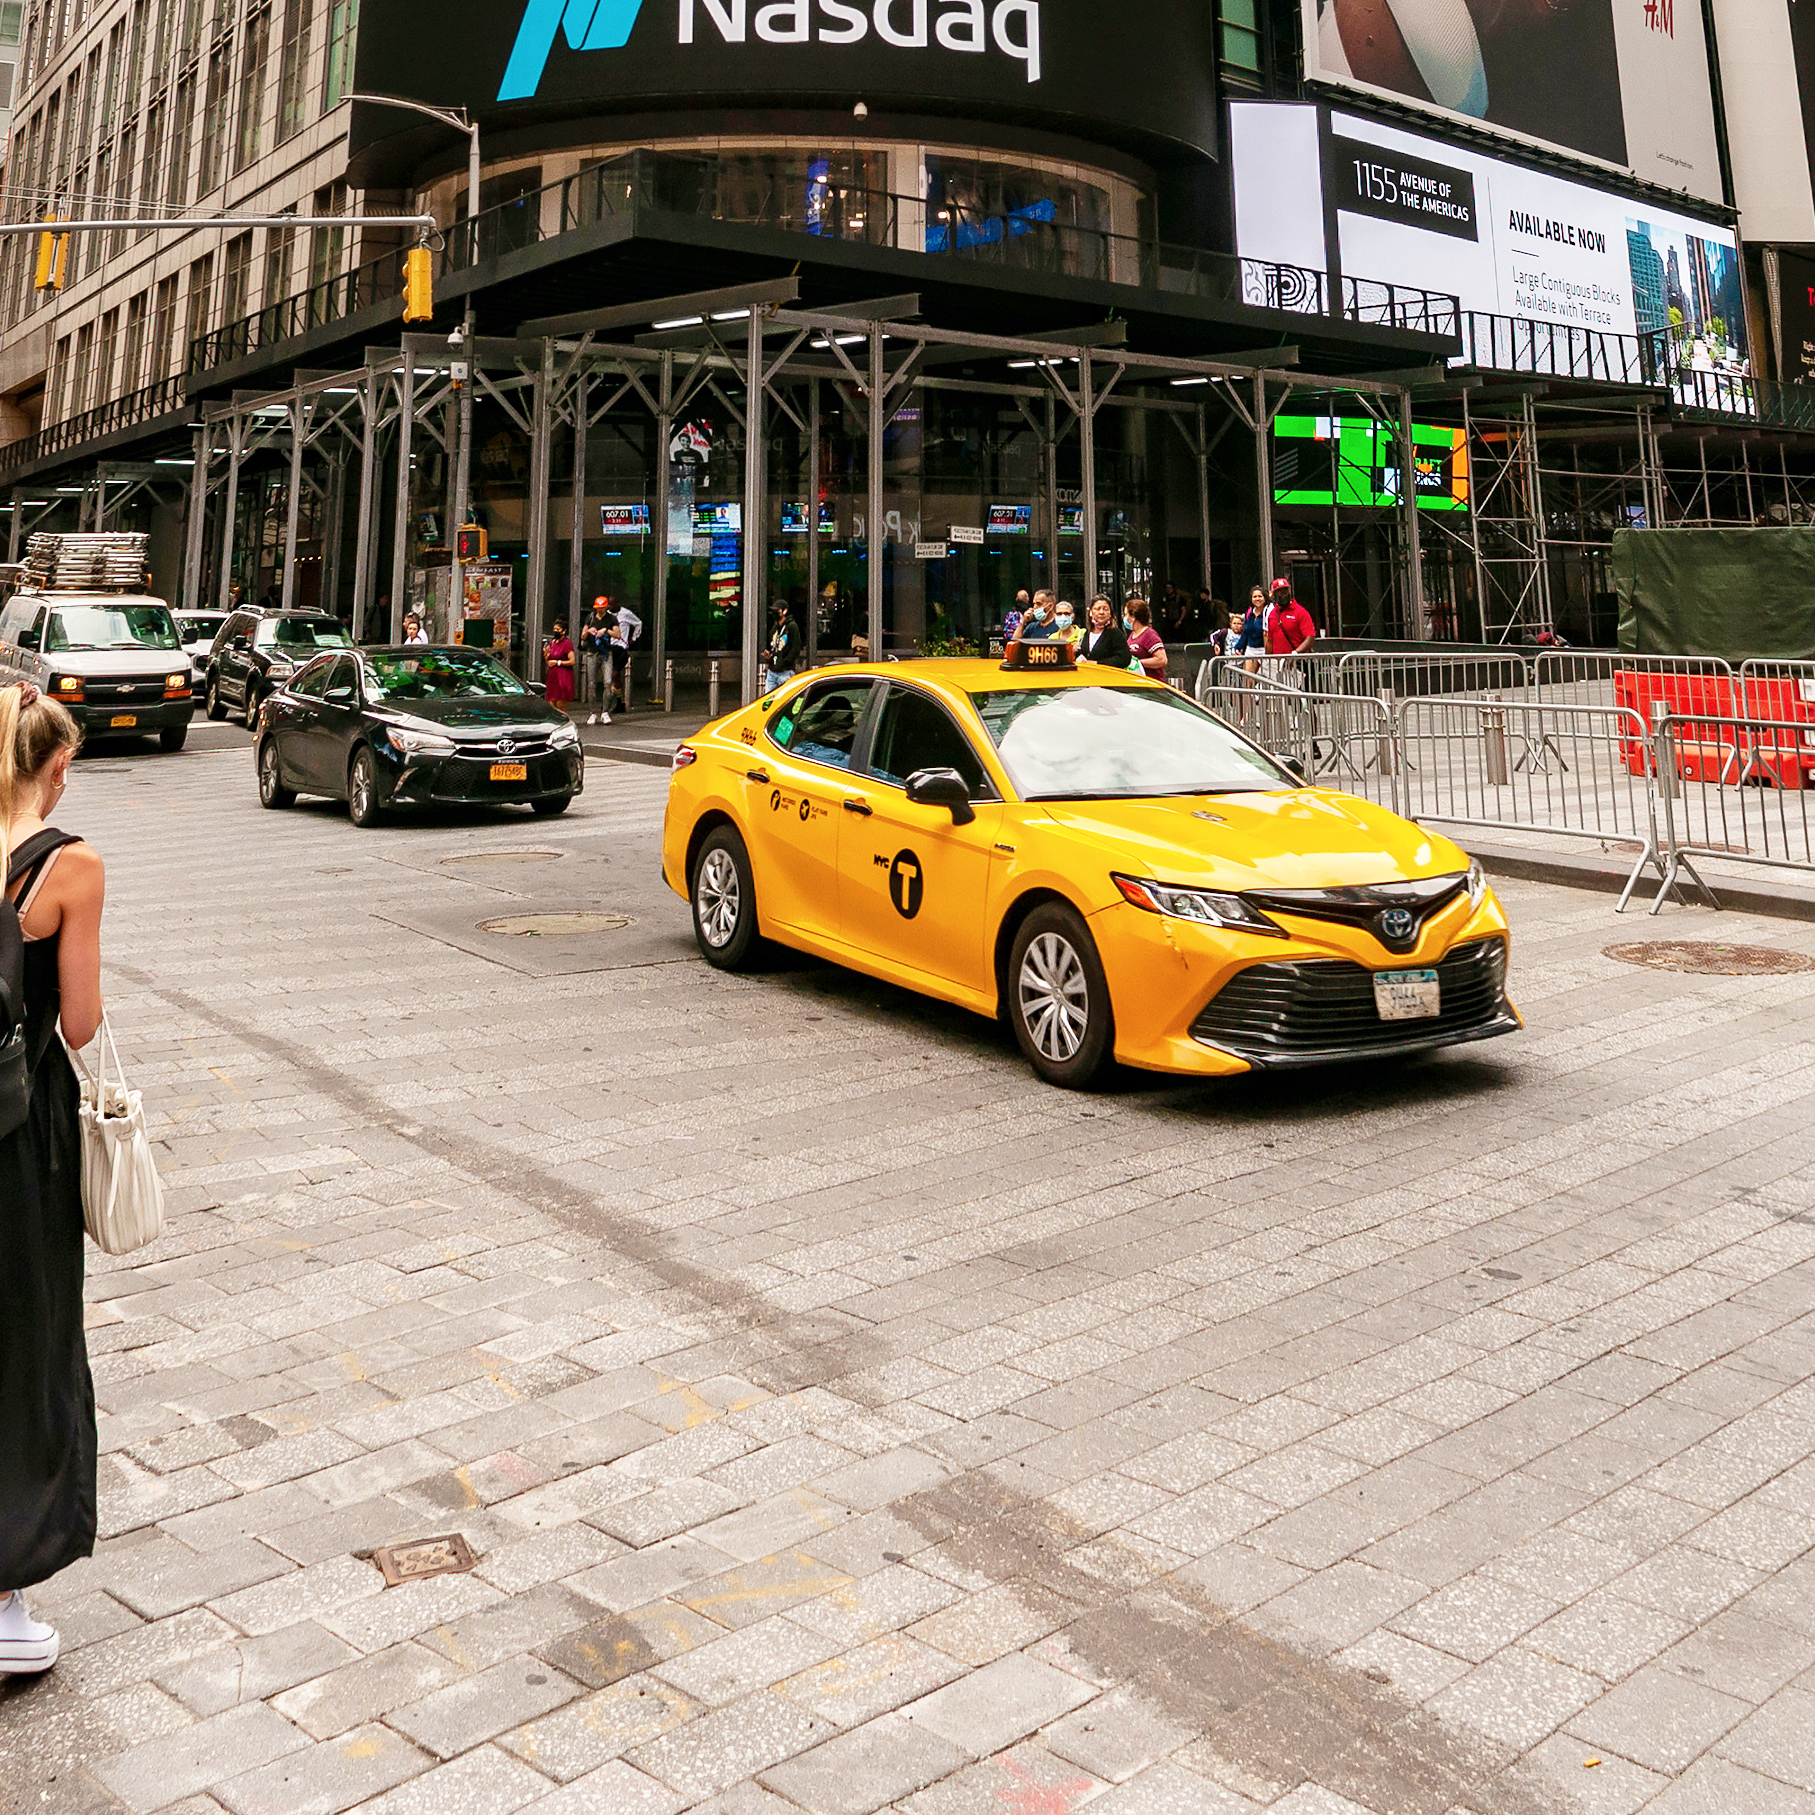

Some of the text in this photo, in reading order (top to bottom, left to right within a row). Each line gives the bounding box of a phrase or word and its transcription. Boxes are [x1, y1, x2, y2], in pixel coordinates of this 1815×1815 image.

[1353, 160, 1451, 203] 1155 AVENUE OF
[1400, 190, 1469, 222] THE AMERICAS
[1509, 209, 1606, 253] AVAILABLE NOW
[1512, 265, 1621, 306] Large Contiguous Blocks
[1515, 289, 1611, 325] Available with Terrace
[1028, 646, 1058, 664] 9H66
[873, 853, 918, 911] NYC T
